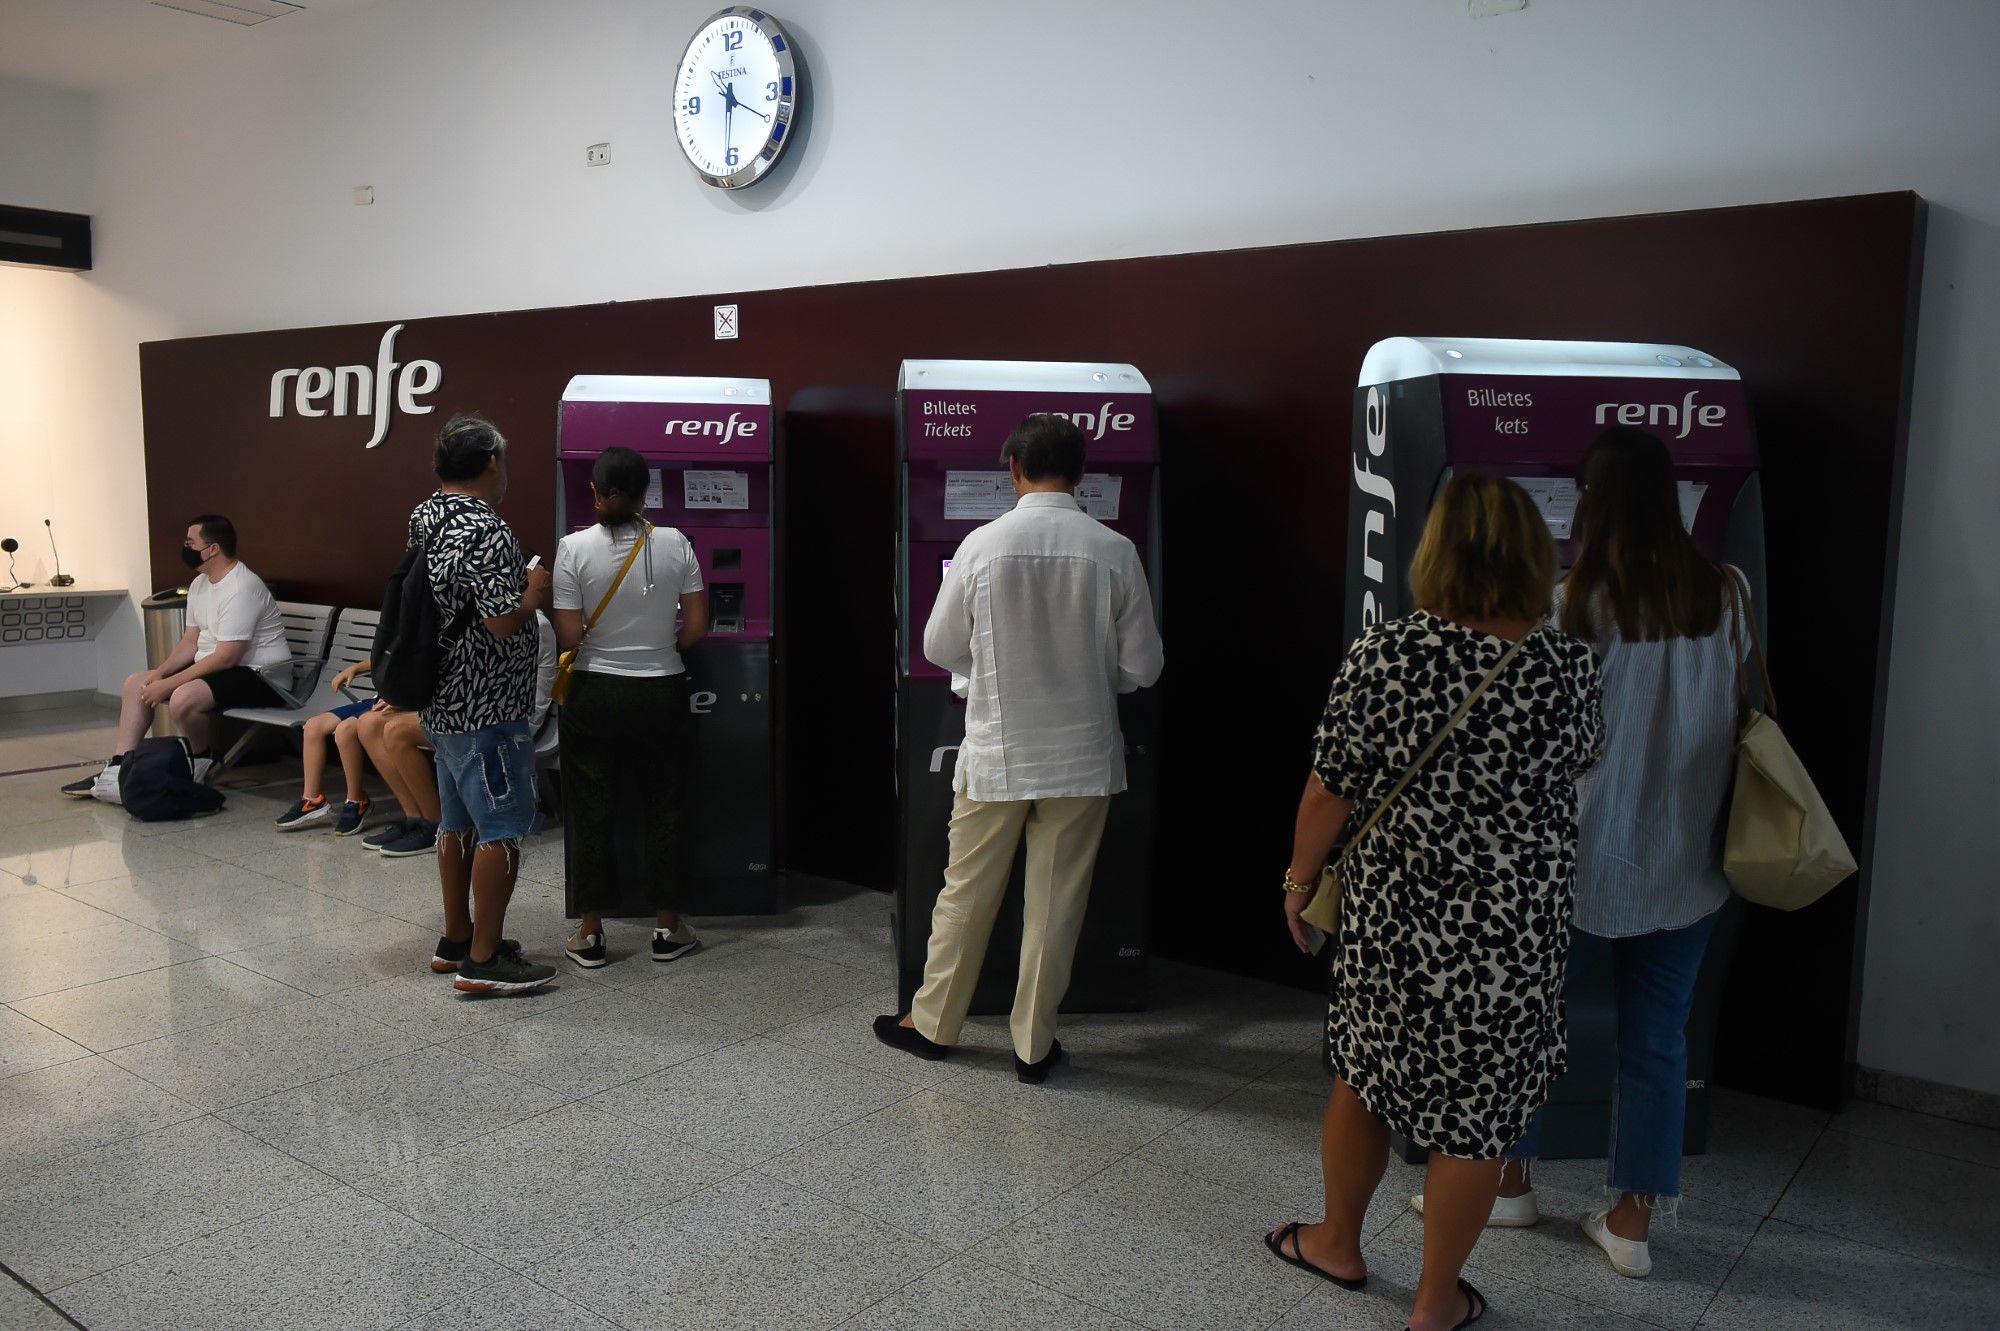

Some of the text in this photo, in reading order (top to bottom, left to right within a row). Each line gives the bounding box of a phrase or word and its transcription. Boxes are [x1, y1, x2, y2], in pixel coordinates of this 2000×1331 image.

[722, 30, 744, 52] 12
[766, 82, 779, 102] 3
[688, 96, 701, 116] 9
[725, 147, 739, 166] 6
[269, 324, 442, 449] renfe
[1467, 388, 1534, 407] Billetes
[923, 400, 977, 416] Billetes
[1595, 390, 1727, 439] renfe
[665, 412, 758, 445] renfe
[924, 422, 972, 437] Tickets
[1029, 402, 1136, 441] nfe
[1495, 416, 1529, 435] kets
[1353, 386, 1396, 632] enfe
